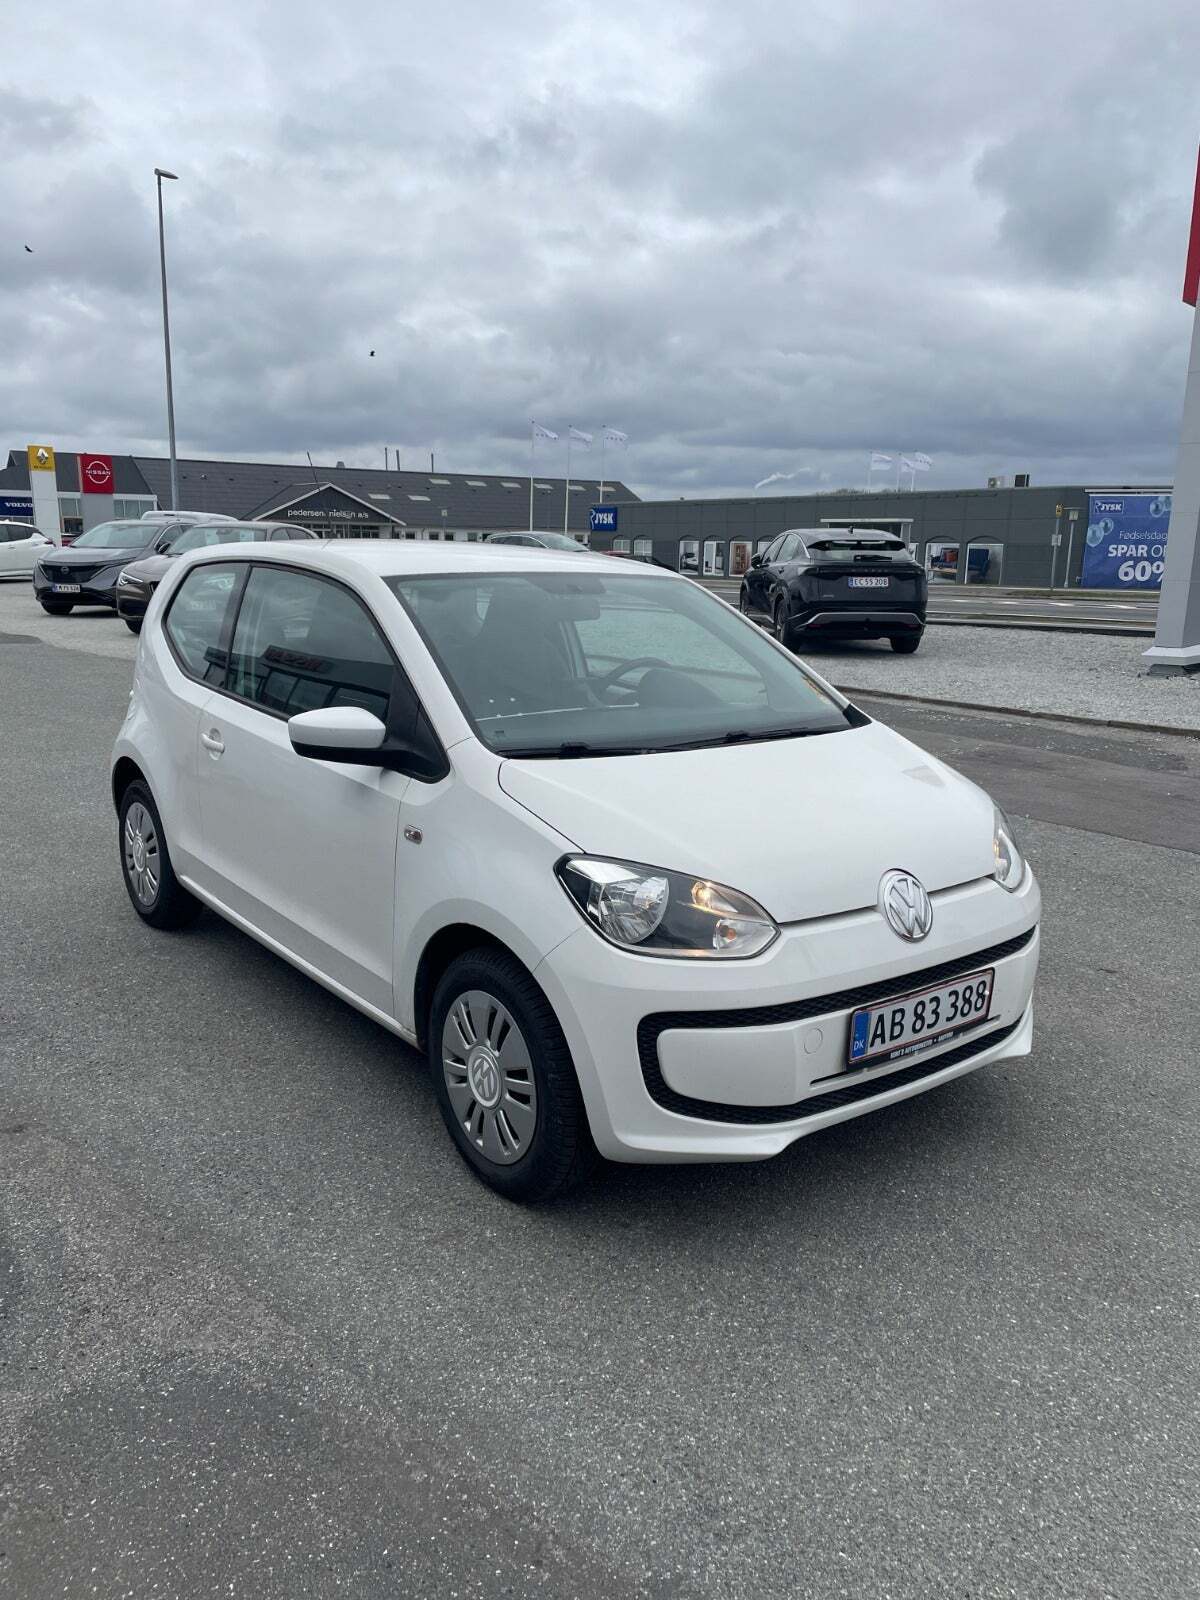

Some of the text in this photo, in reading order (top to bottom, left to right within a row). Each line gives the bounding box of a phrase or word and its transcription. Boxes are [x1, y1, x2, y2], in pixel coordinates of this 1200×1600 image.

[1100, 503, 1122, 511] JYSK
[594, 513, 614, 524] JYSK
[1108, 544, 1148, 557] SPAR
[869, 1007, 906, 1048] AB
[911, 995, 941, 1034] 83
[945, 980, 988, 1023] 388
[853, 1039, 865, 1051] DK
